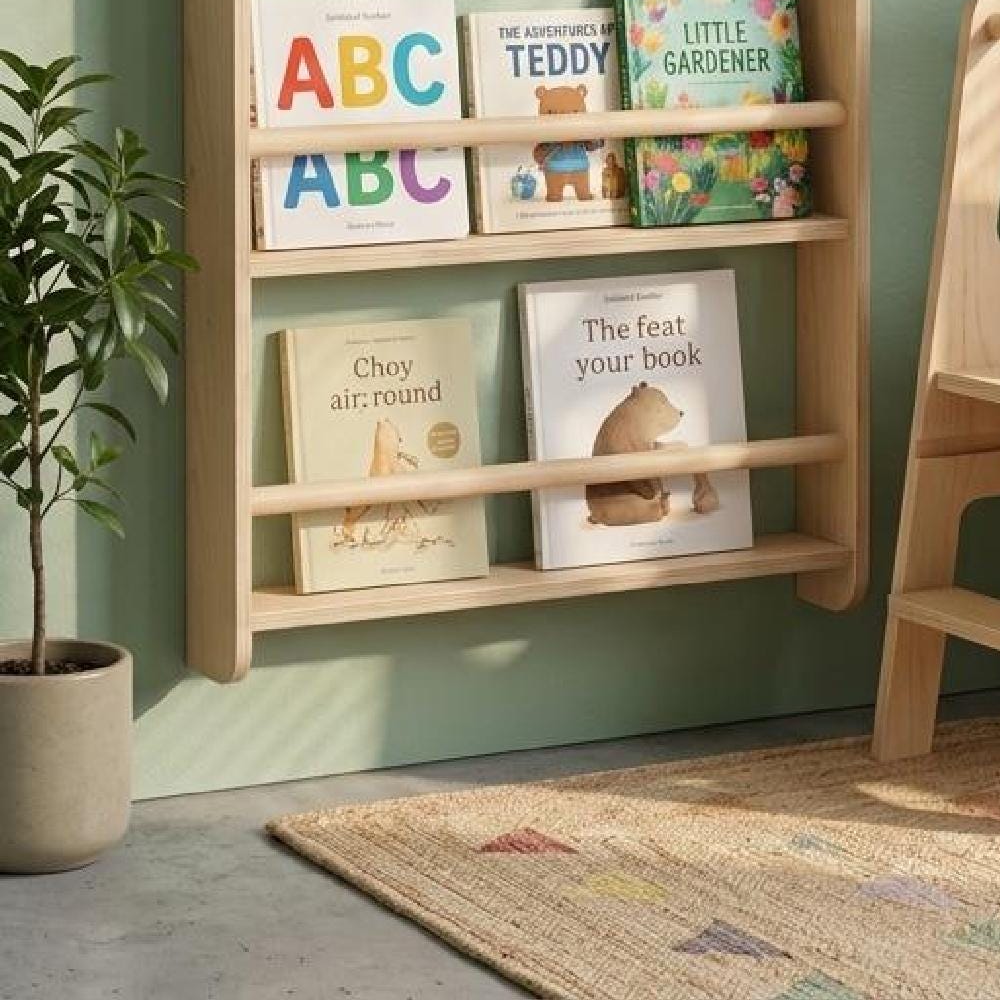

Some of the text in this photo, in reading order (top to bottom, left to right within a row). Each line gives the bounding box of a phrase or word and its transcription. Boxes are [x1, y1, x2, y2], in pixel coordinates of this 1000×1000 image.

[683, 20, 748, 44] LITTLE
[277, 32, 445, 110] ABC
[505, 42, 611, 78] TEDDY
[664, 48, 771, 76] GARDENER
[582, 315, 687, 342] The feat
[353, 355, 414, 382] Choy
[576, 342, 703, 382] your book
[373, 379, 442, 408] round
